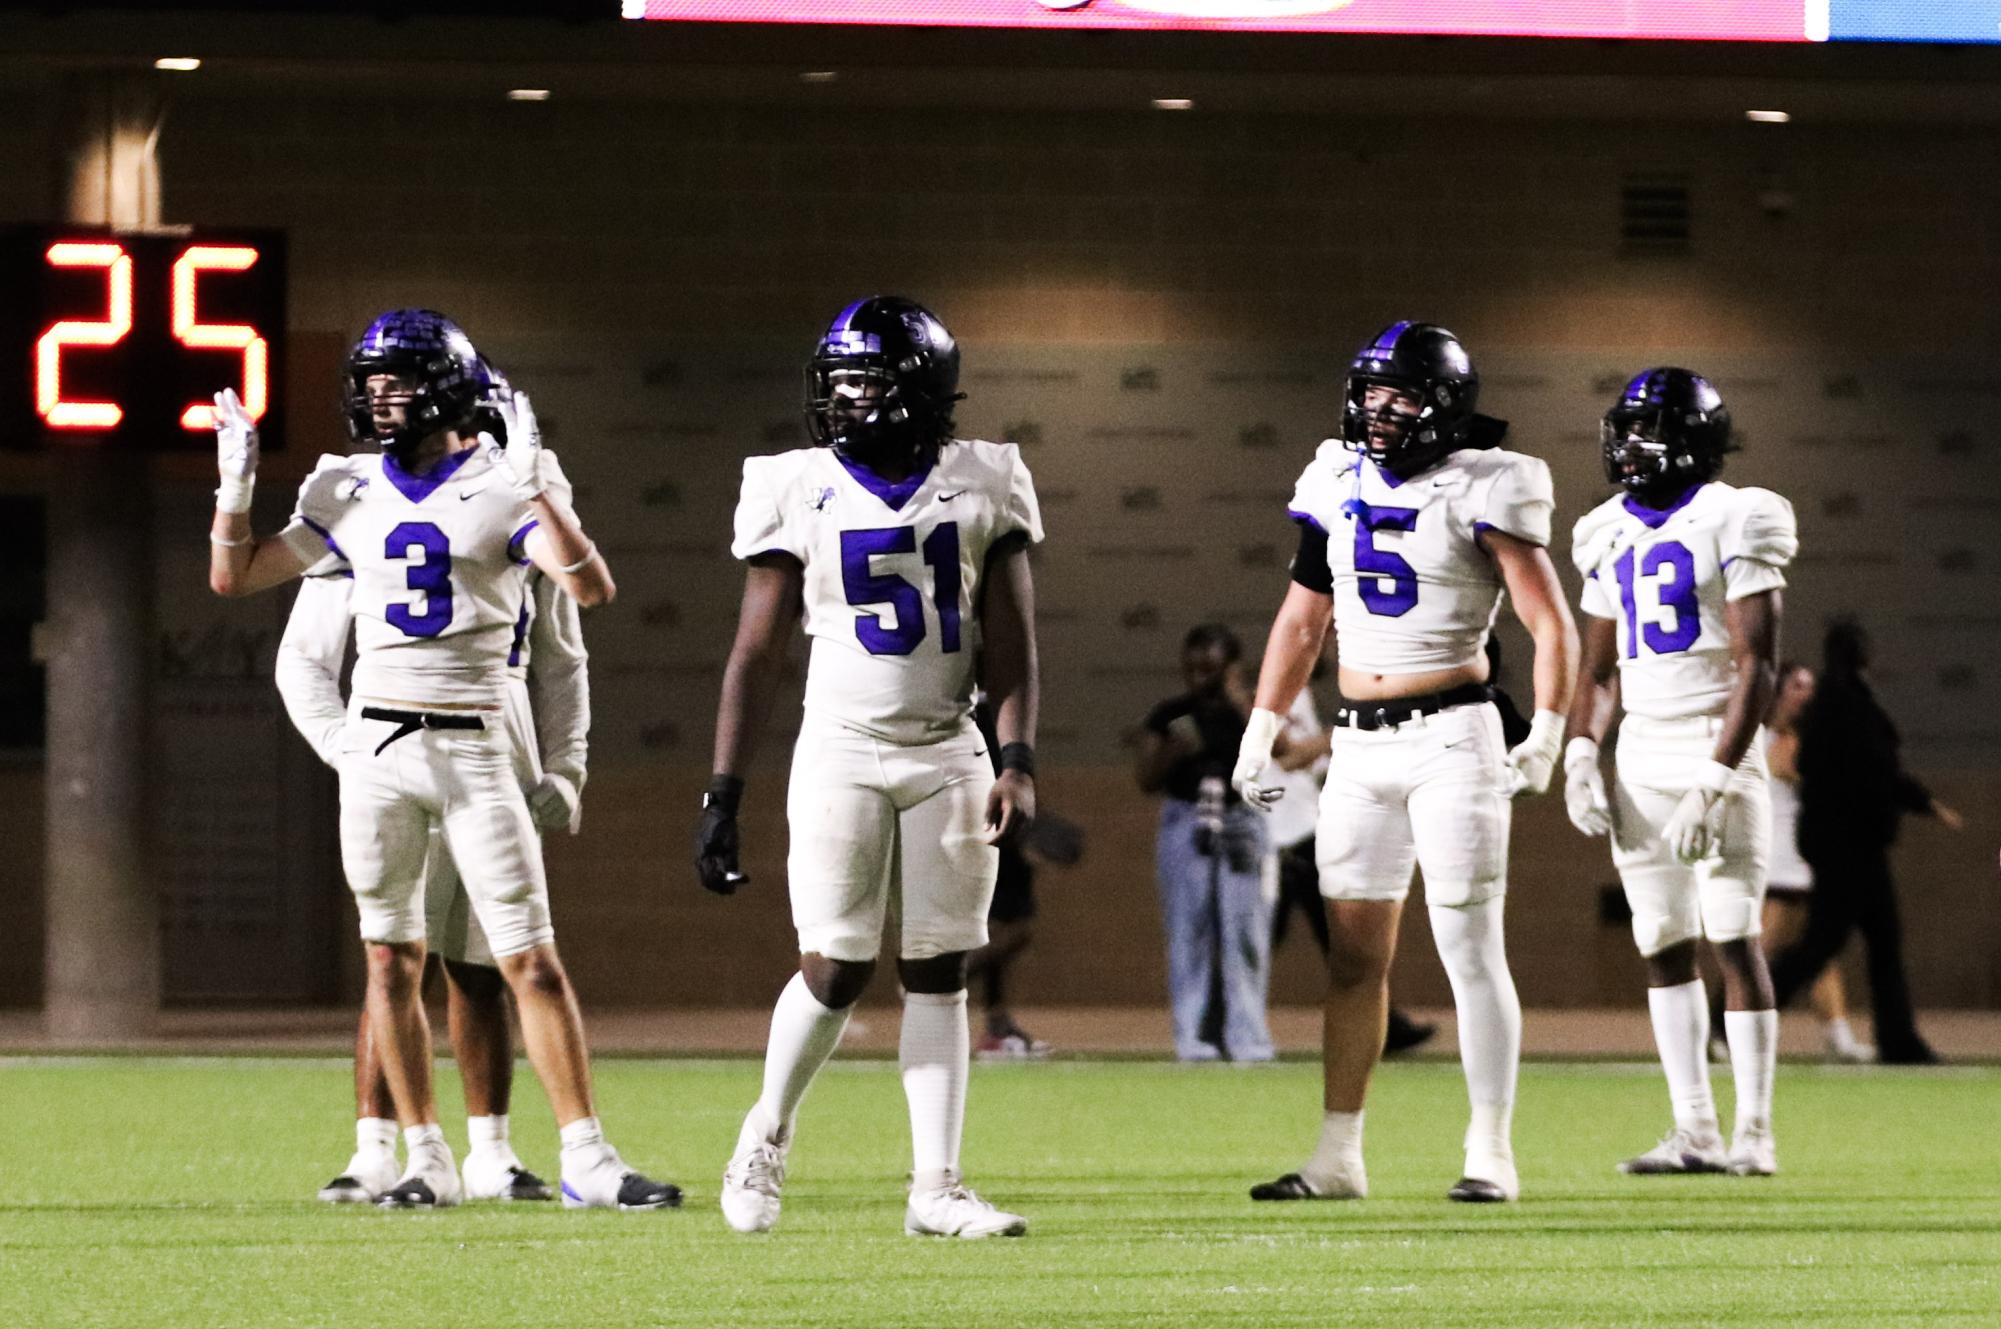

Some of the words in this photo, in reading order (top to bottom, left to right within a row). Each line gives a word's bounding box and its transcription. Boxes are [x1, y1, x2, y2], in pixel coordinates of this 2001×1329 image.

[36, 242, 268, 430] 25
[384, 521, 453, 638] 3
[840, 521, 962, 656] 51
[1354, 504, 1419, 618] 5
[1613, 540, 1702, 659] 13
